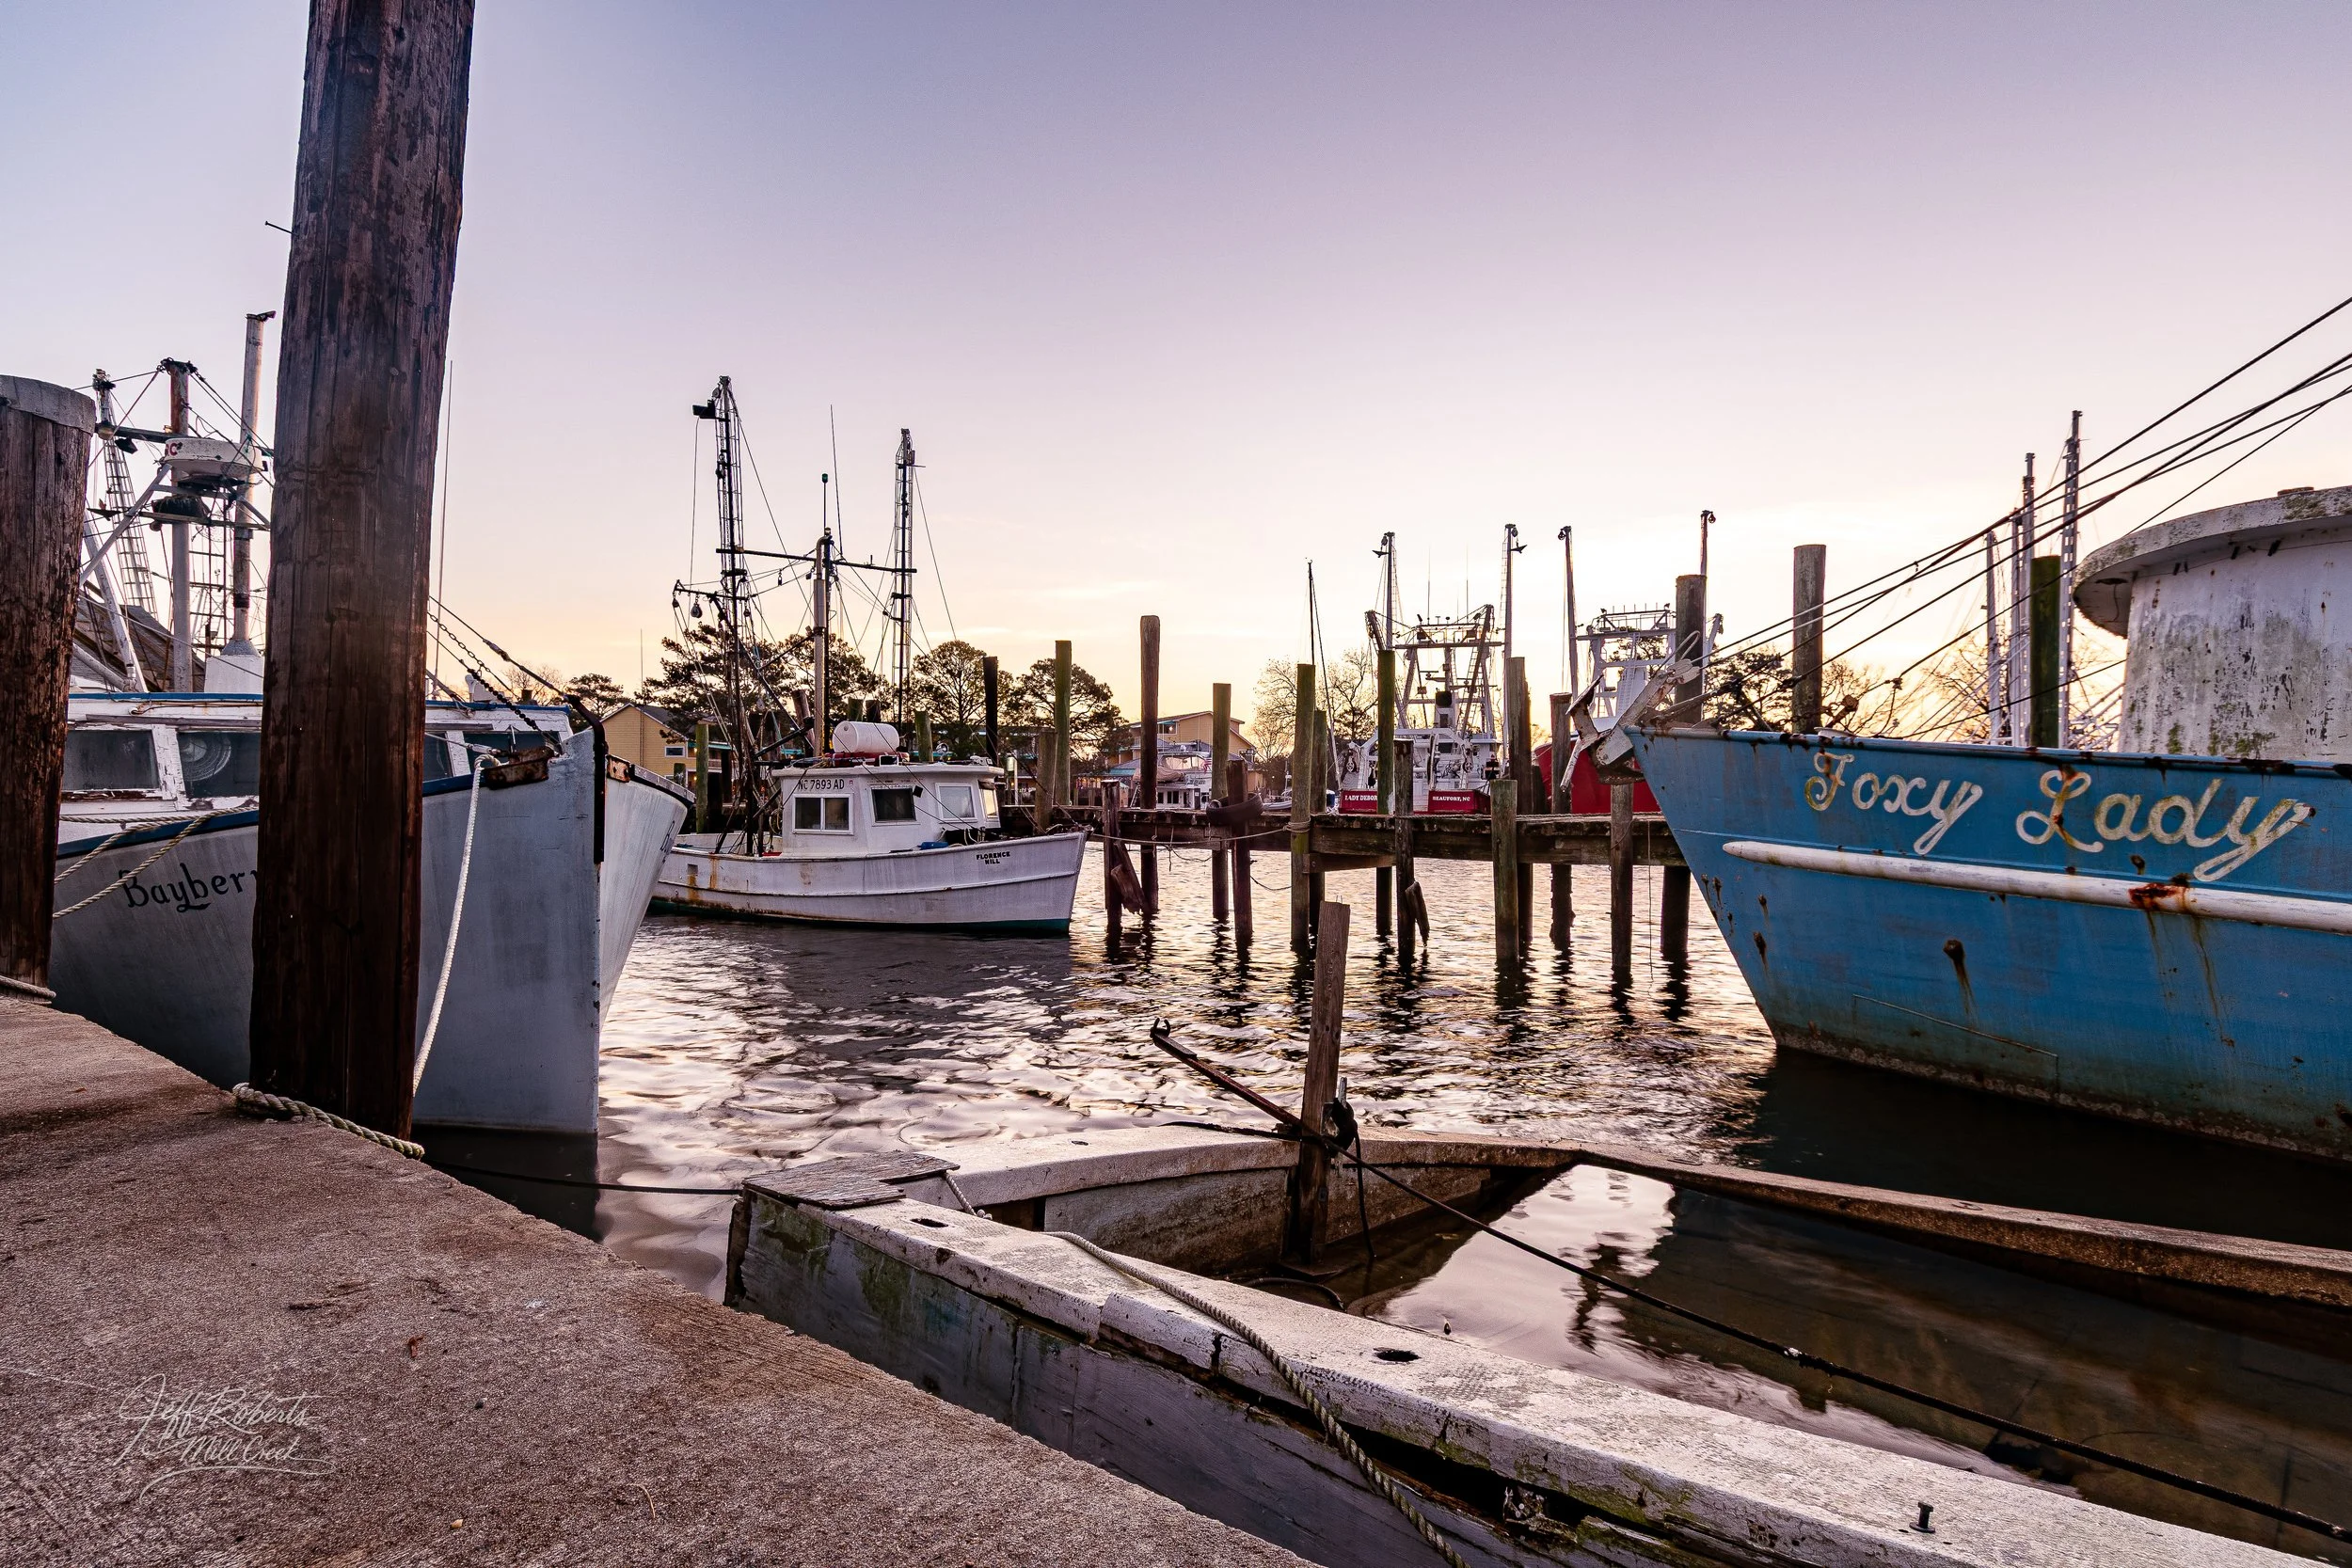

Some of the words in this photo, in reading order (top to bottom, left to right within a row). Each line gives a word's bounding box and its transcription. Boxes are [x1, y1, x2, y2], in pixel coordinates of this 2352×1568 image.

[798, 779, 808, 790] NC
[810, 779, 832, 790] 7893
[834, 779, 845, 790] AD
[1804, 752, 1983, 856] Foxy
[2015, 769, 2317, 882] Lady
[976, 851, 1010, 860] FLORENCE
